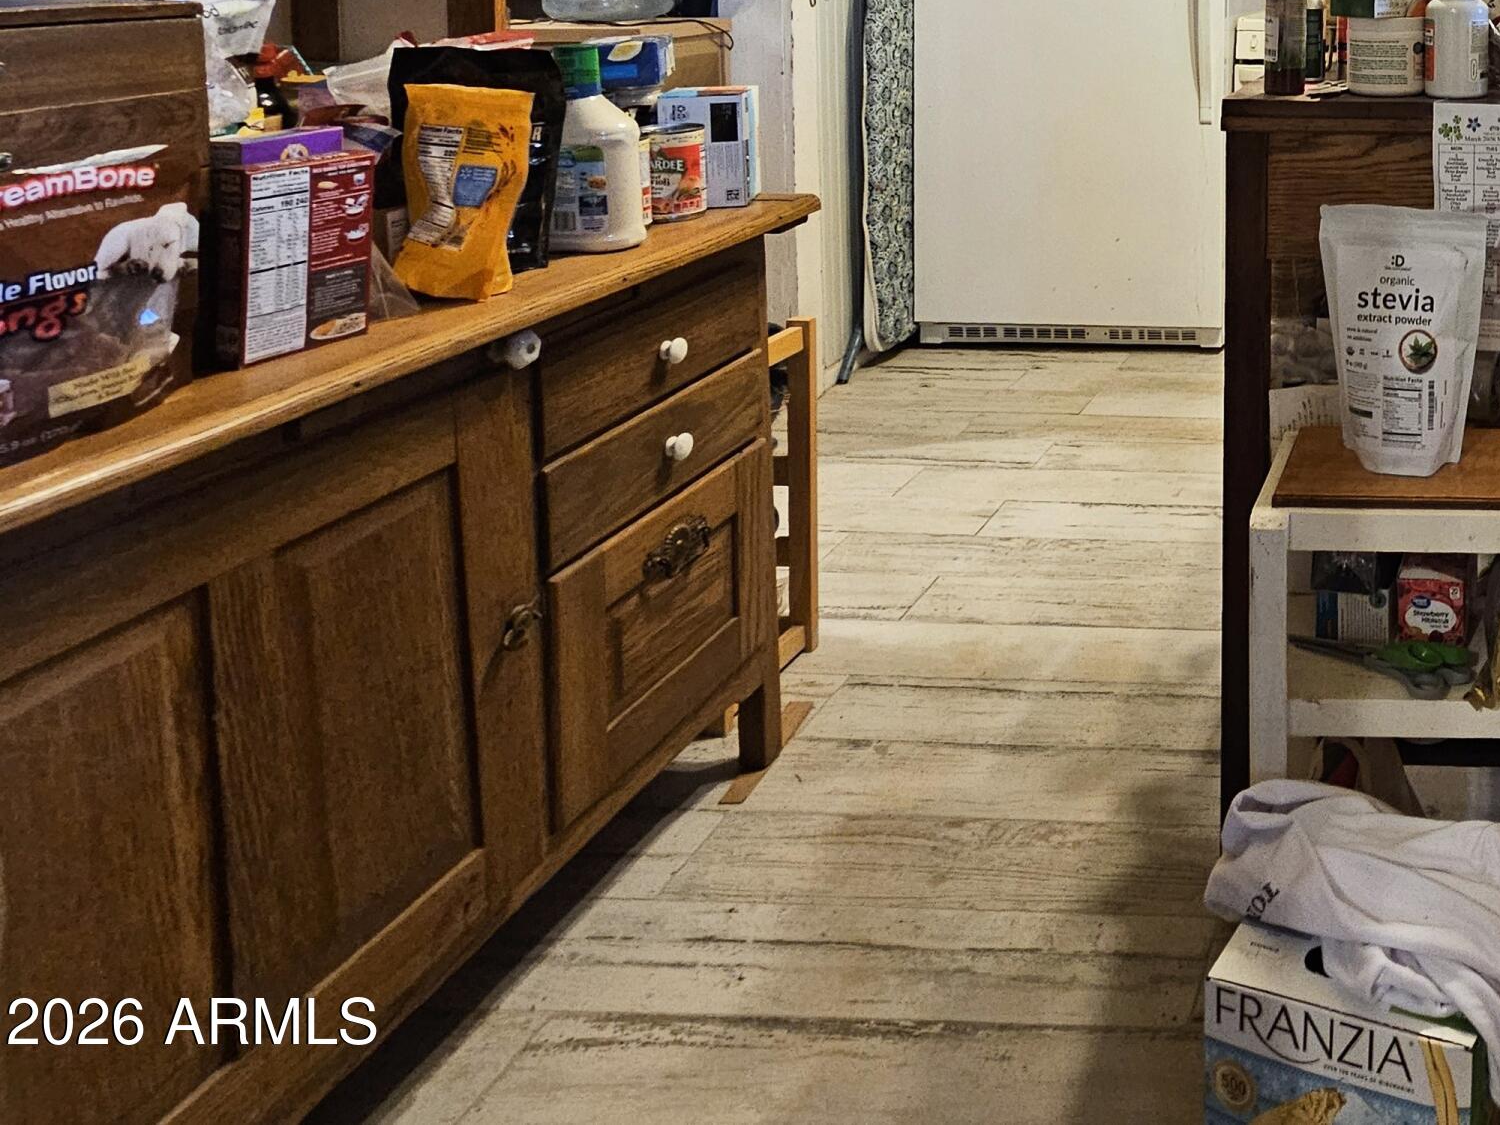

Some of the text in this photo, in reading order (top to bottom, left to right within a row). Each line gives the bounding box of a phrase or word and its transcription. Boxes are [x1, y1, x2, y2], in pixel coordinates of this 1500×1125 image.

[1379, 275, 1415, 287] organic
[1357, 287, 1435, 313] stevia
[1357, 312, 1432, 327] extract powder
[1215, 986, 1413, 1083] FRANZIA
